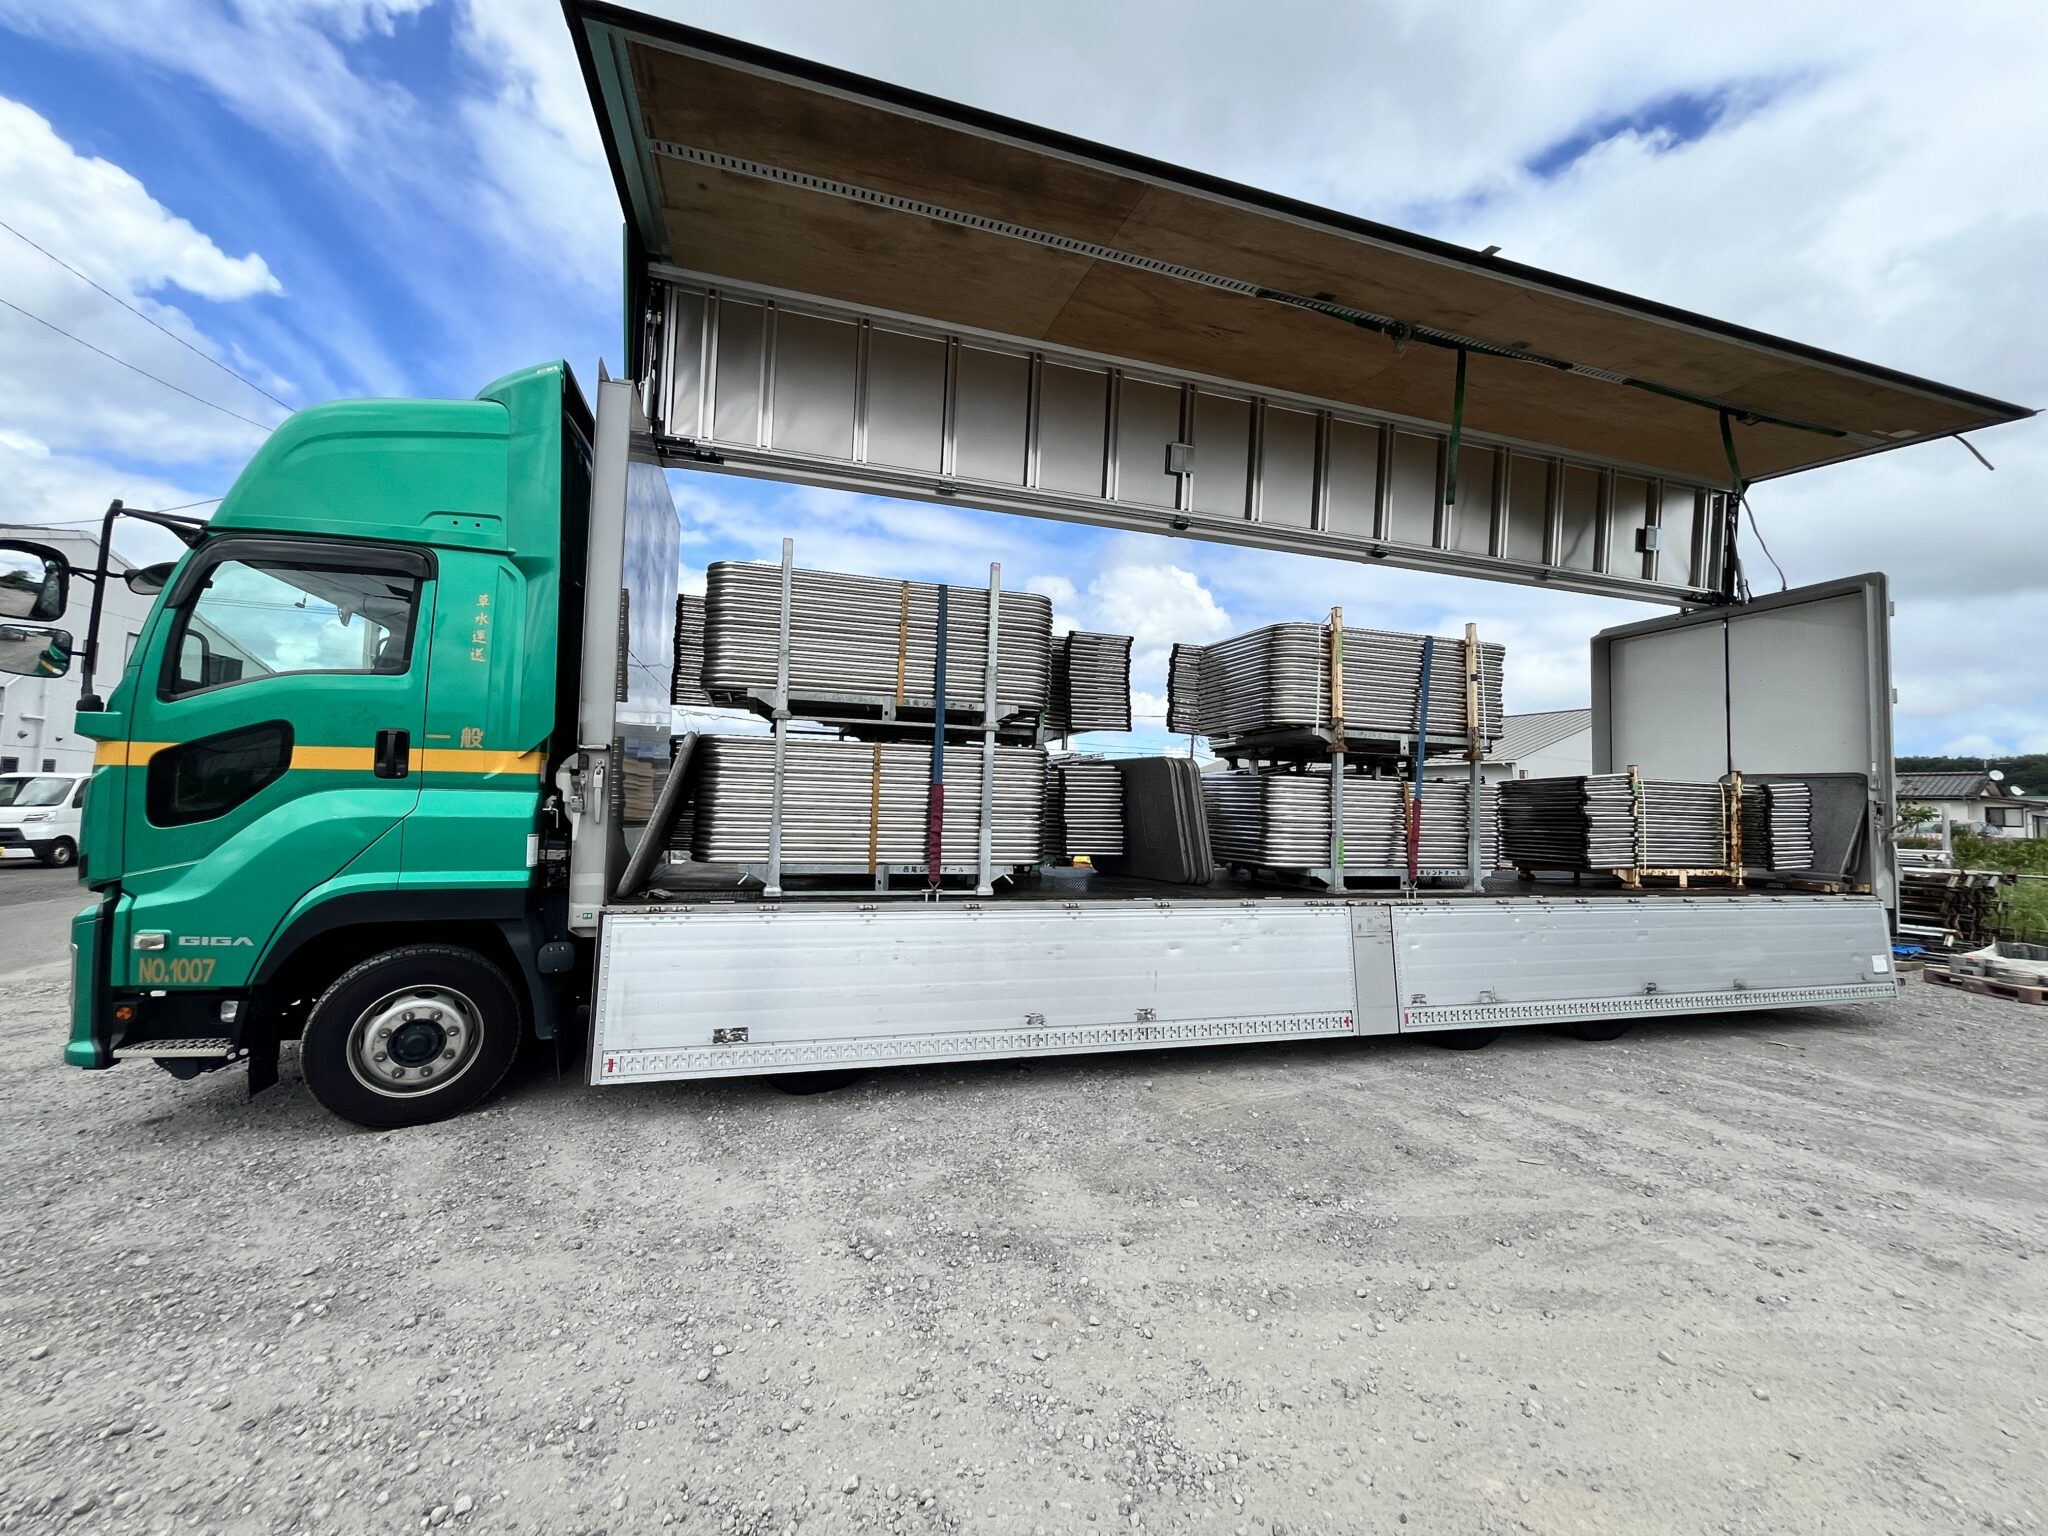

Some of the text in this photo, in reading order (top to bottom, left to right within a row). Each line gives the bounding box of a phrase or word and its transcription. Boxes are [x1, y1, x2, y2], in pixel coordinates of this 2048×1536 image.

[426, 727, 484, 749] 一般
[178, 936, 254, 946] GIGA
[139, 958, 216, 983] NO.1007
